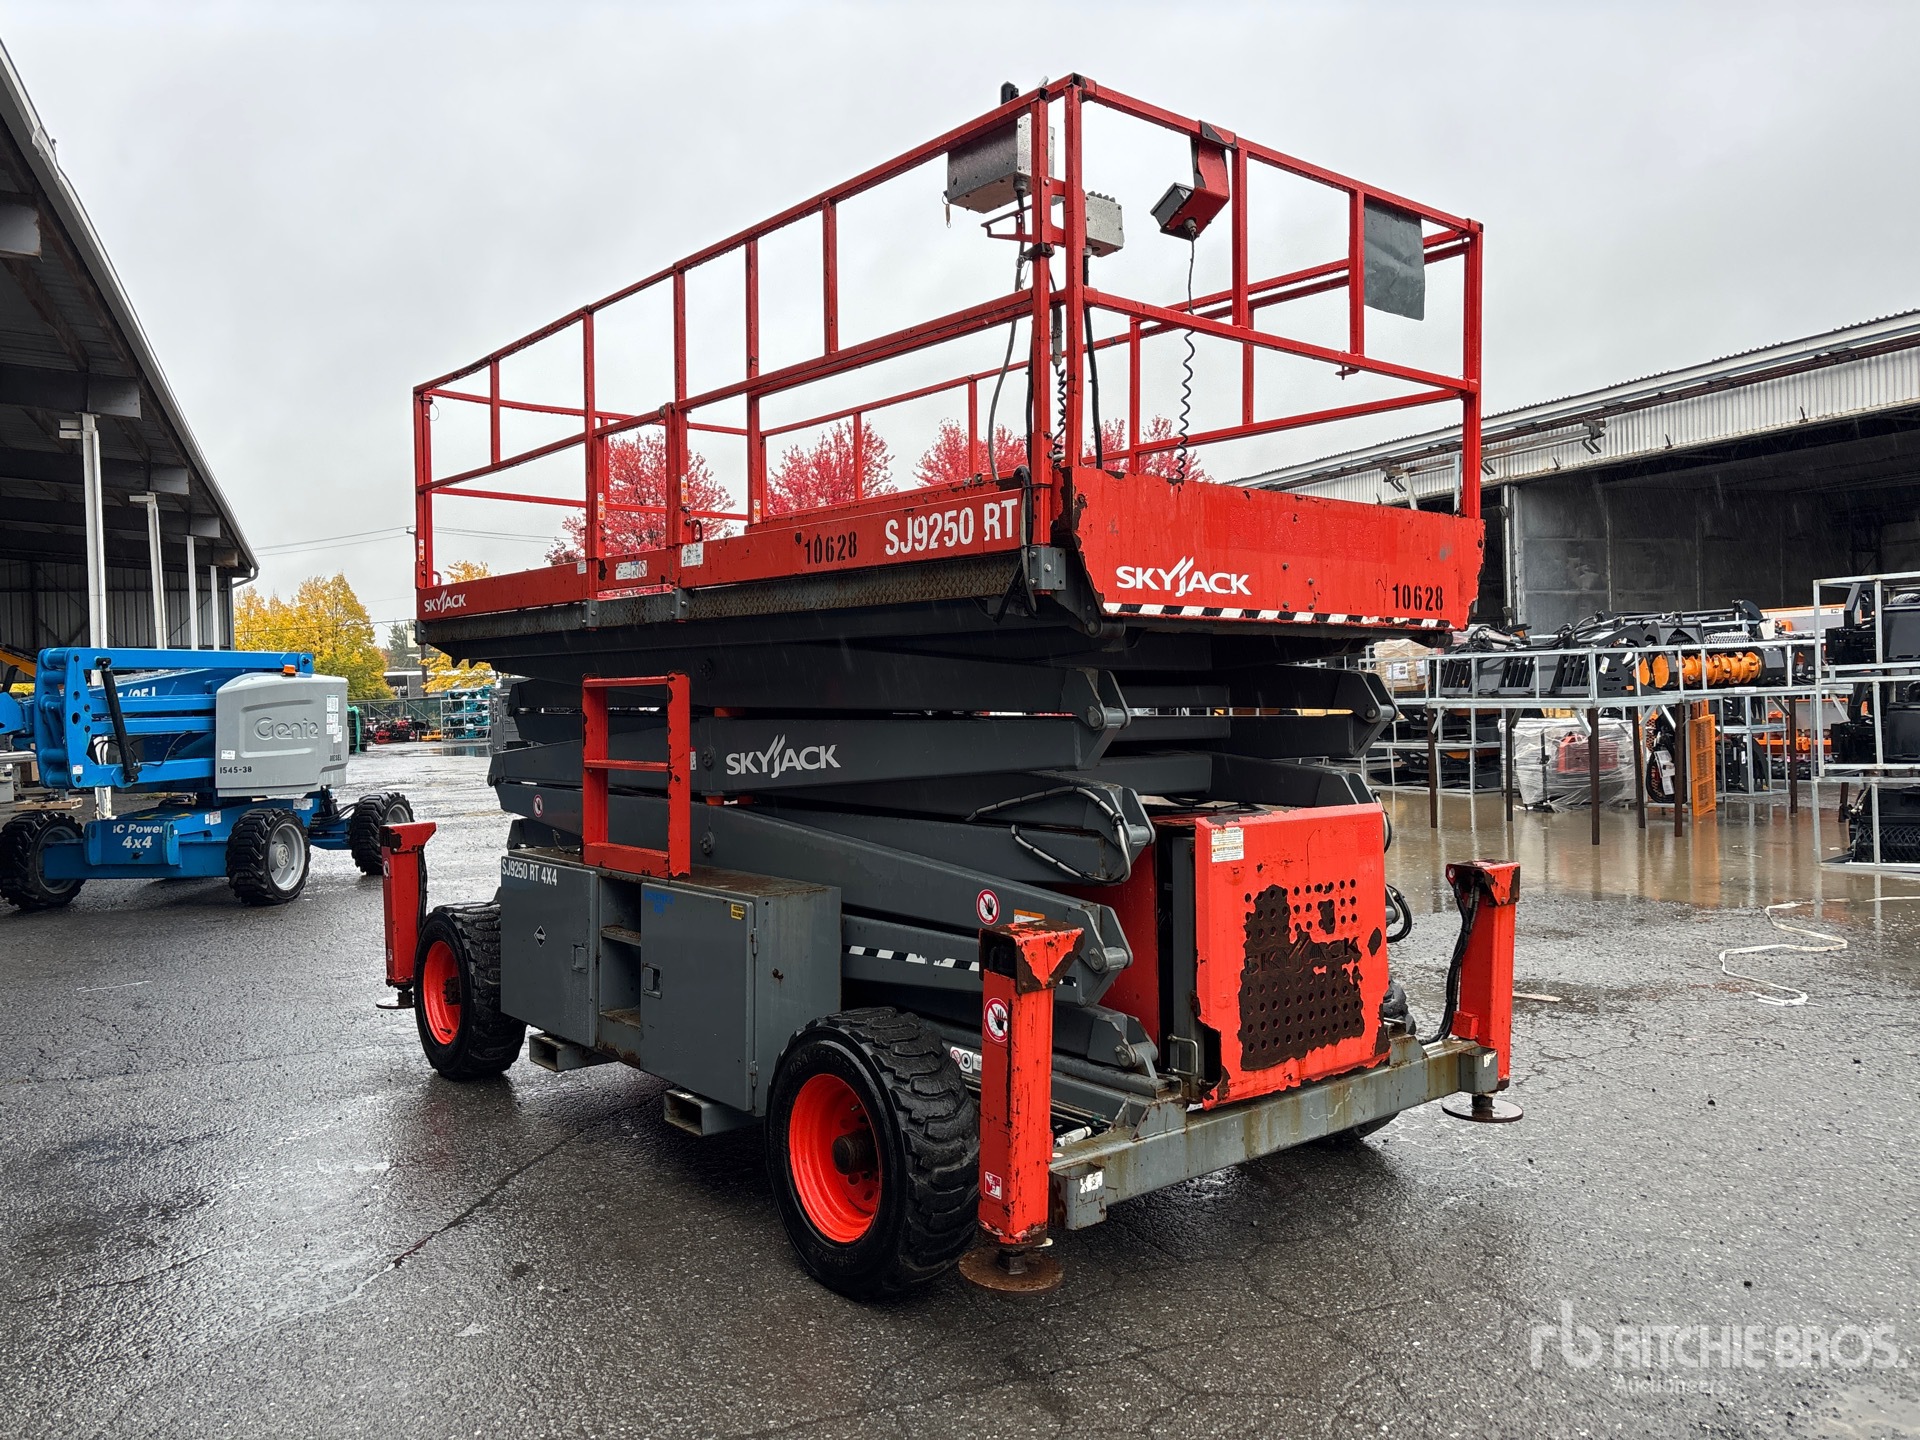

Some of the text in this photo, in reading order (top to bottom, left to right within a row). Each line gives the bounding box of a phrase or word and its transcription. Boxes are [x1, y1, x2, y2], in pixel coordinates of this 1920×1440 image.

[885, 498, 1018, 556] SJ9250 RT
[804, 531, 857, 564] 10628
[1115, 555, 1252, 597] SKYJACK
[424, 589, 466, 613] SKYJACK
[1391, 584, 1444, 612] 10628
[254, 717, 319, 740] Genie
[725, 734, 841, 779] SKYJACK
[127, 823, 163, 834] Power
[502, 858, 558, 886] SJ9250 RT 4X4
